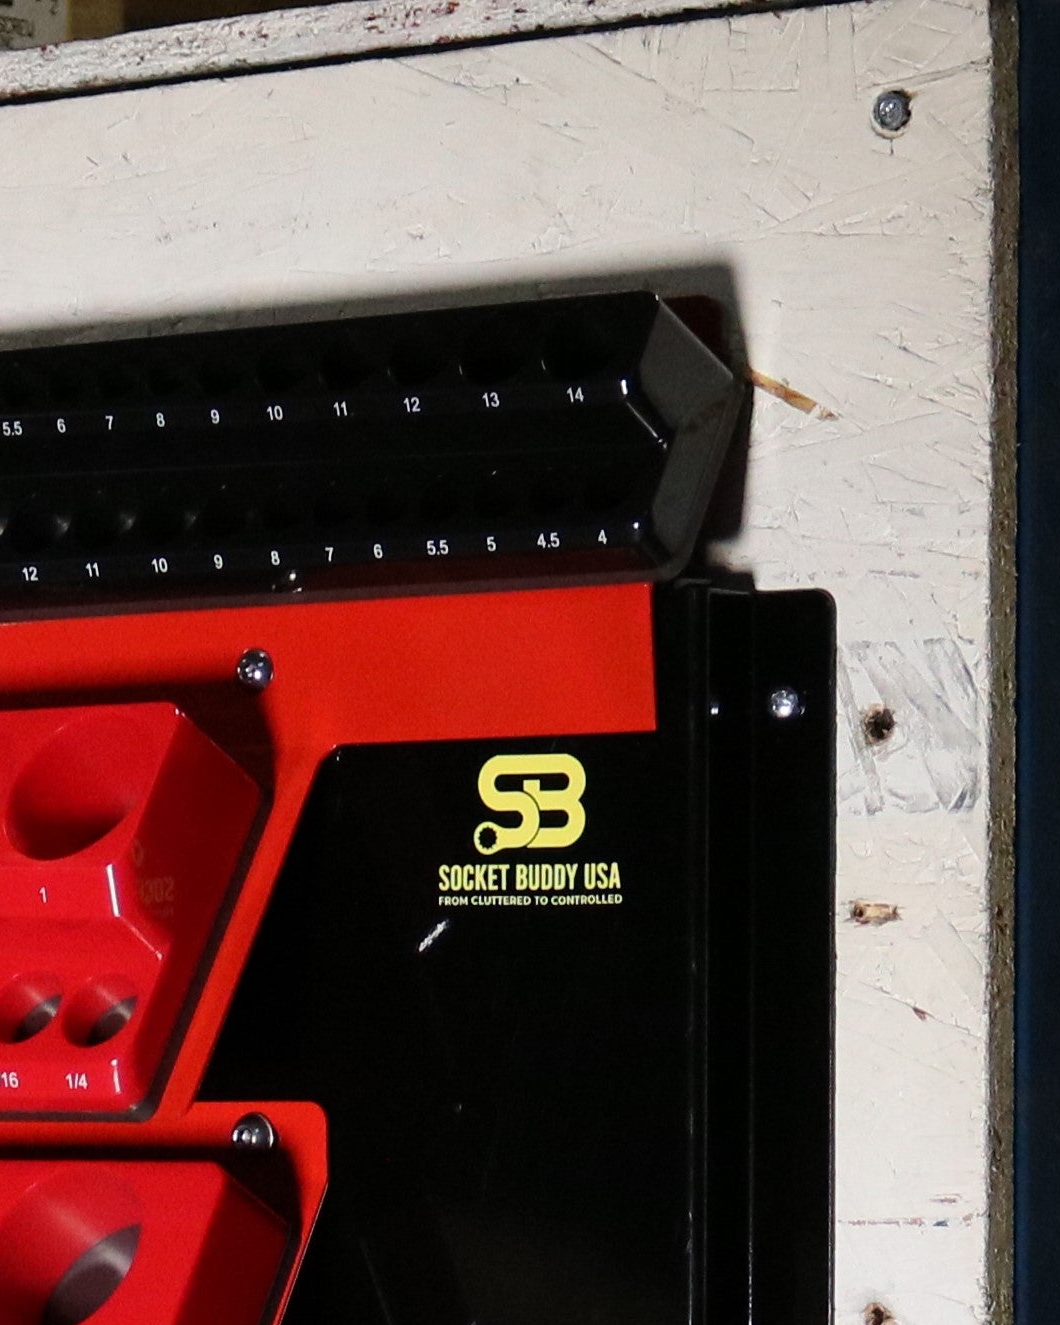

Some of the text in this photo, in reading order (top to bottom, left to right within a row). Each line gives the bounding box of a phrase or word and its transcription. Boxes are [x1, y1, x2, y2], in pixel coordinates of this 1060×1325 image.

[2, 420, 23, 437] 5.5
[56, 418, 67, 434] 6
[105, 415, 114, 430] 7
[155, 412, 166, 428] 8
[210, 409, 220, 425] 9
[266, 405, 284, 421] 10
[333, 400, 348, 417] 11
[403, 396, 421, 413] 12
[482, 391, 500, 408] 13
[566, 386, 585, 403] 14
[22, 566, 39, 582] 12
[85, 562, 100, 578] 11
[151, 557, 168, 573] 10
[213, 554, 224, 570] 9
[270, 550, 281, 566] 8
[324, 546, 334, 562] 7
[373, 543, 383, 559] 6
[426, 539, 449, 556] 5.5
[486, 536, 497, 552] 5
[536, 532, 560, 549] 4.5
[597, 529, 608, 545] 4
[473, 753, 587, 856] SB
[438, 862, 621, 891] SOCKET BUDDY USA
[39, 886, 47, 904] 1
[438, 894, 623, 906] FROM CLUTTERED TO CONTROLLED
[65, 1073, 88, 1089] 1/4
